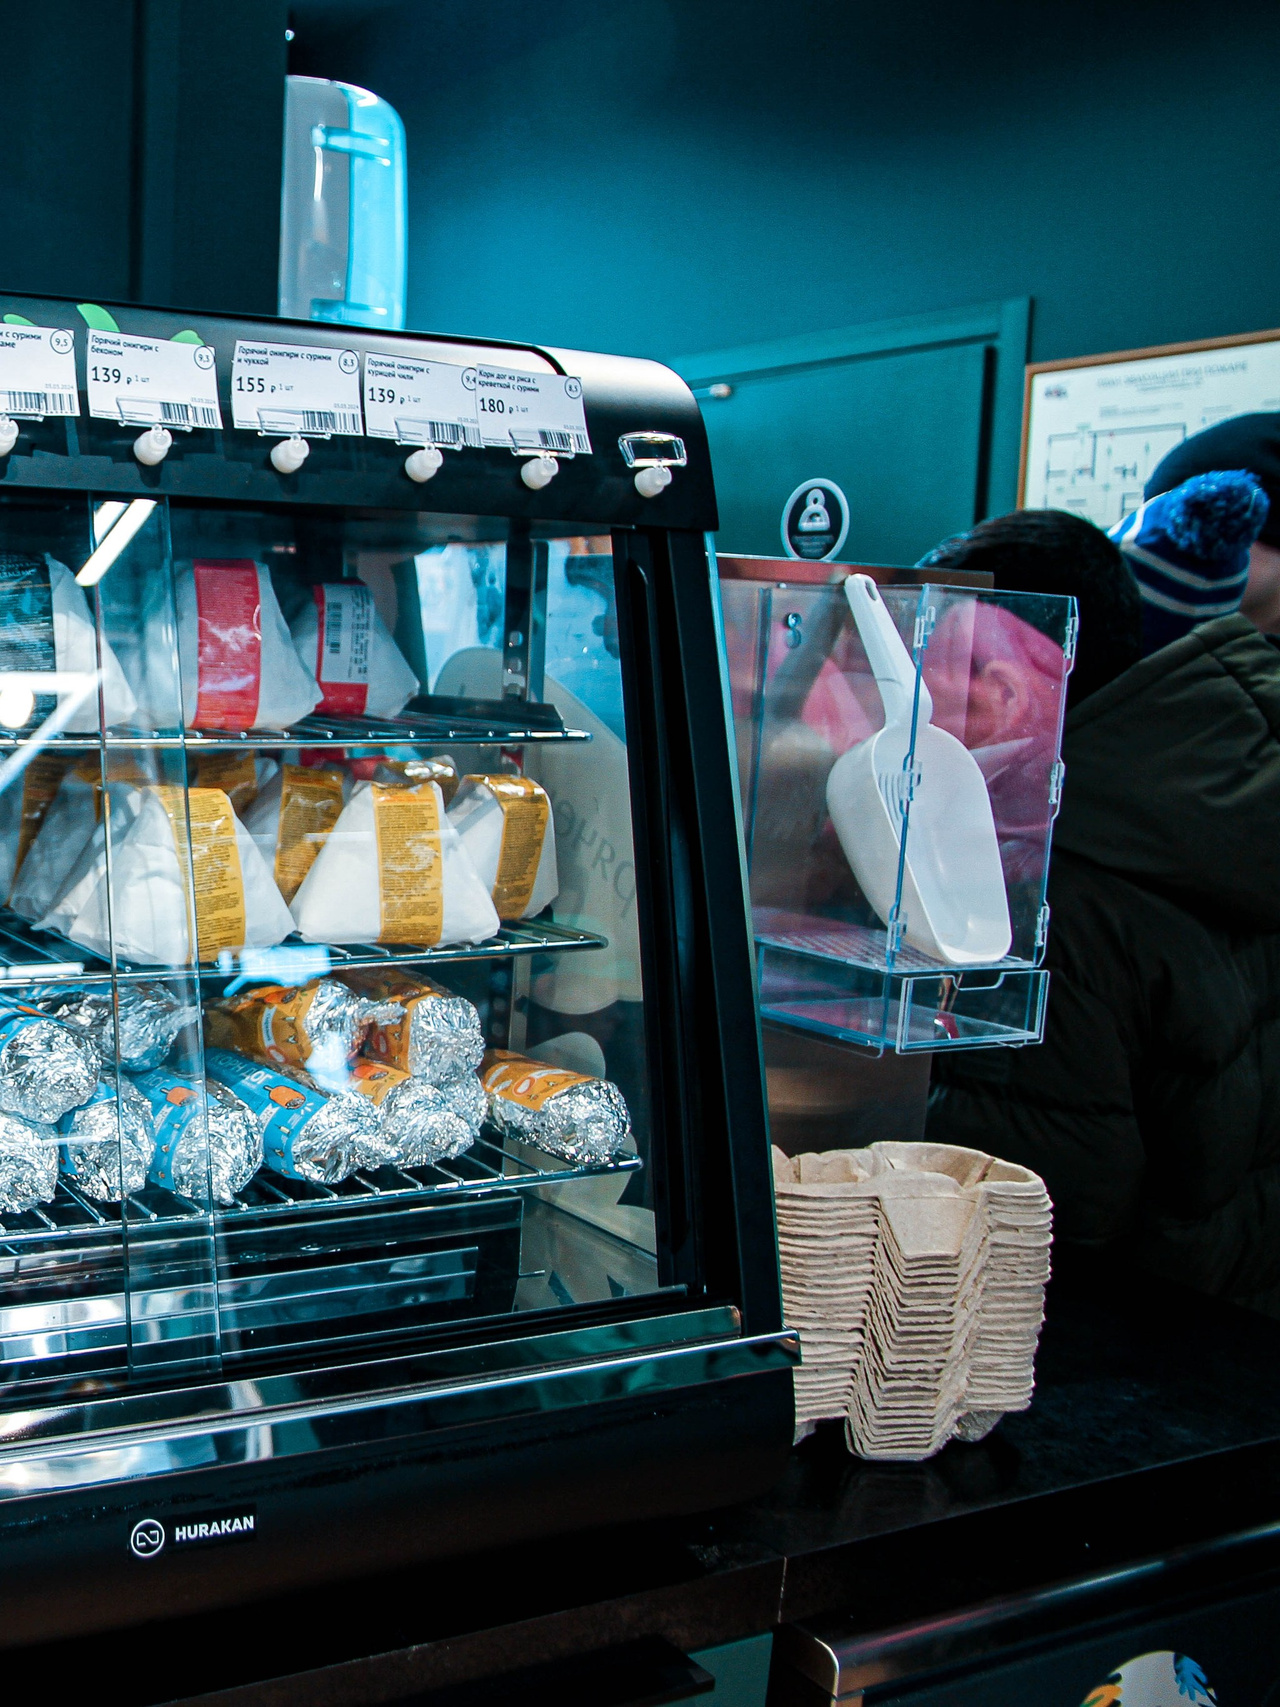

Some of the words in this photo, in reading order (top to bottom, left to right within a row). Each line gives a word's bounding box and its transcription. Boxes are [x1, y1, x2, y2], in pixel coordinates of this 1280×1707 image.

[12, 332, 42, 340] сурими
[55, 338, 68, 347] 9,5
[91, 335, 121, 346] Горячий
[123, 340, 153, 351] онигири
[91, 345, 123, 356] беконом
[238, 346, 267, 356] Горячий
[269, 350, 299, 359] онигири
[306, 353, 332, 362] сурими
[243, 357, 269, 366] чуккой
[368, 358, 395, 368] Горячий
[397, 363, 424, 374] онигири
[91, 366, 121, 383] 139
[368, 368, 395, 378] курицей
[479, 370, 494, 379] Корн
[496, 372, 507, 380] дог
[517, 376, 530, 384] риса
[236, 376, 265, 393] 155
[478, 380, 510, 389] креветкой
[517, 385, 539, 393] сурими
[368, 387, 395, 404] 139
[480, 398, 504, 413] 180
[175, 1515, 254, 1542] HURAKAN
